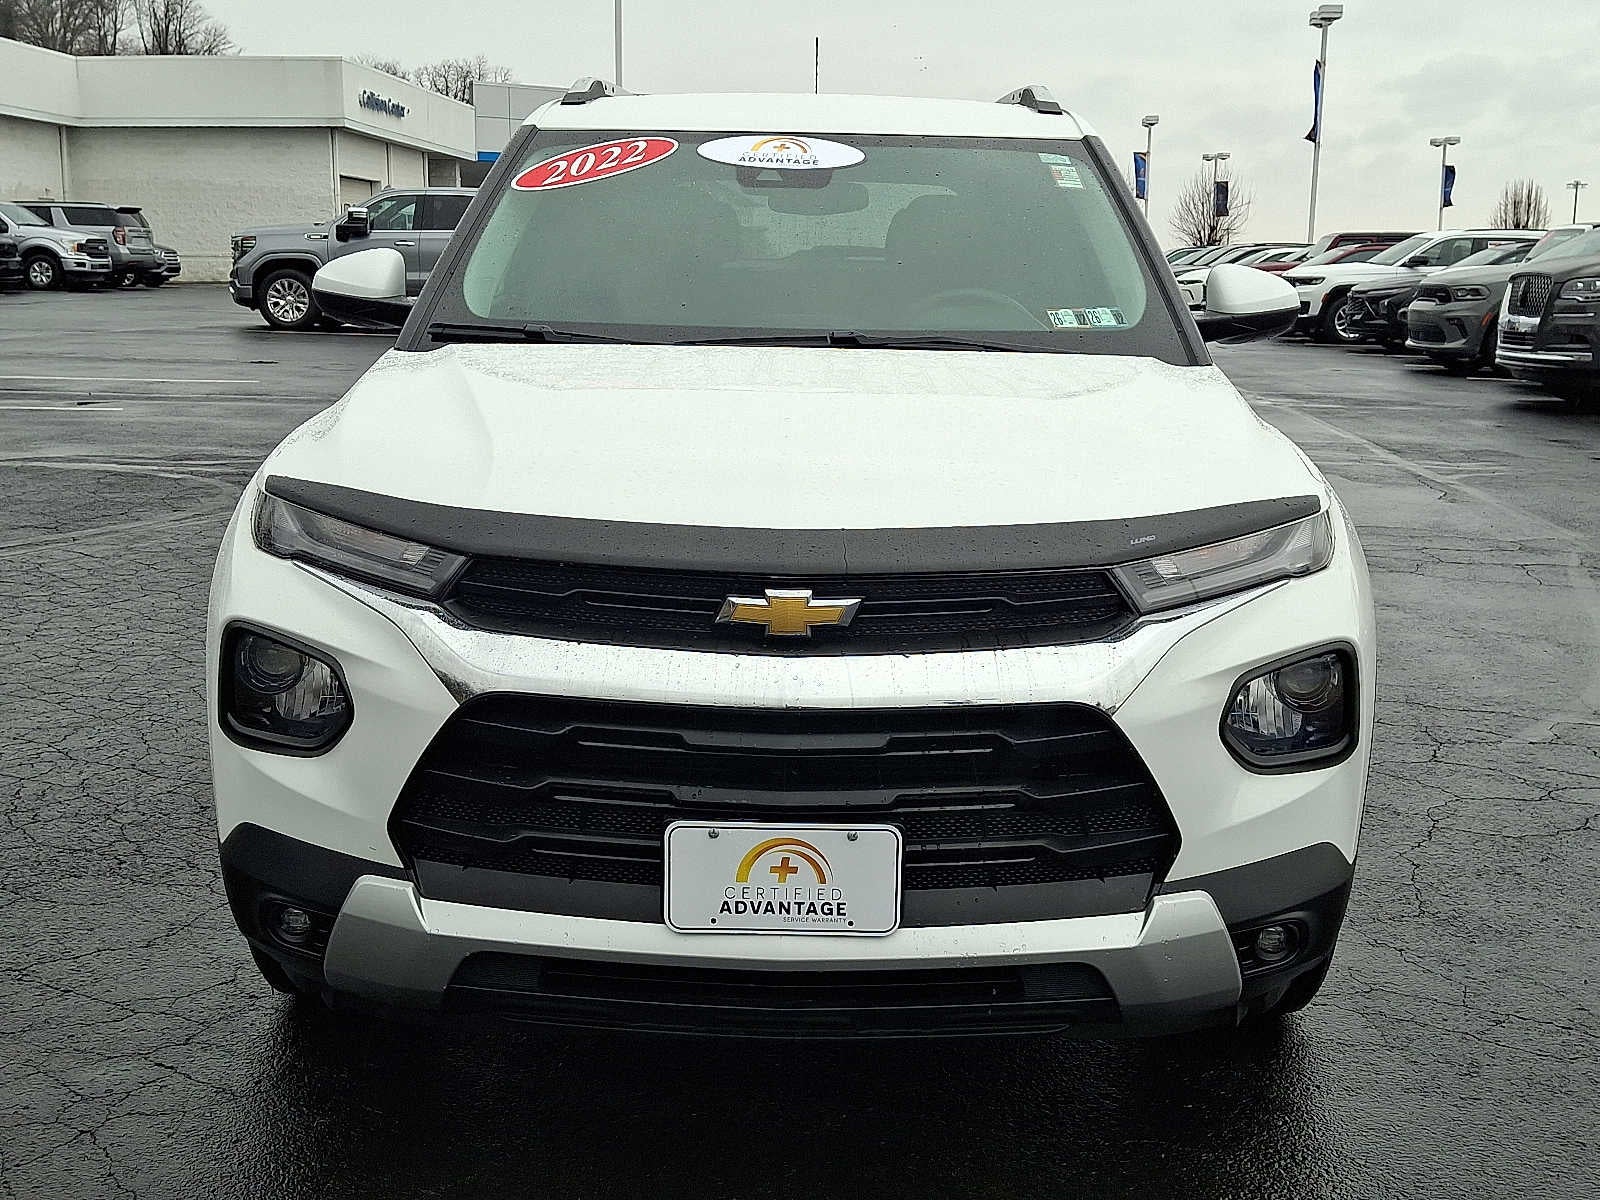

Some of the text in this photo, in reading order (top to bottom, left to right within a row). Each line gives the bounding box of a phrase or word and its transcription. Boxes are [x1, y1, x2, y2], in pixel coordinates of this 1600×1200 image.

[542, 140, 648, 185] 2022
[738, 156, 819, 166] ADVANTAGE
[1049, 312, 1064, 326] 26
[1087, 310, 1102, 324] 26
[1130, 535, 1156, 545] LUND
[724, 886, 842, 901] CERTIFIED
[719, 900, 847, 917] ADVANTAGE
